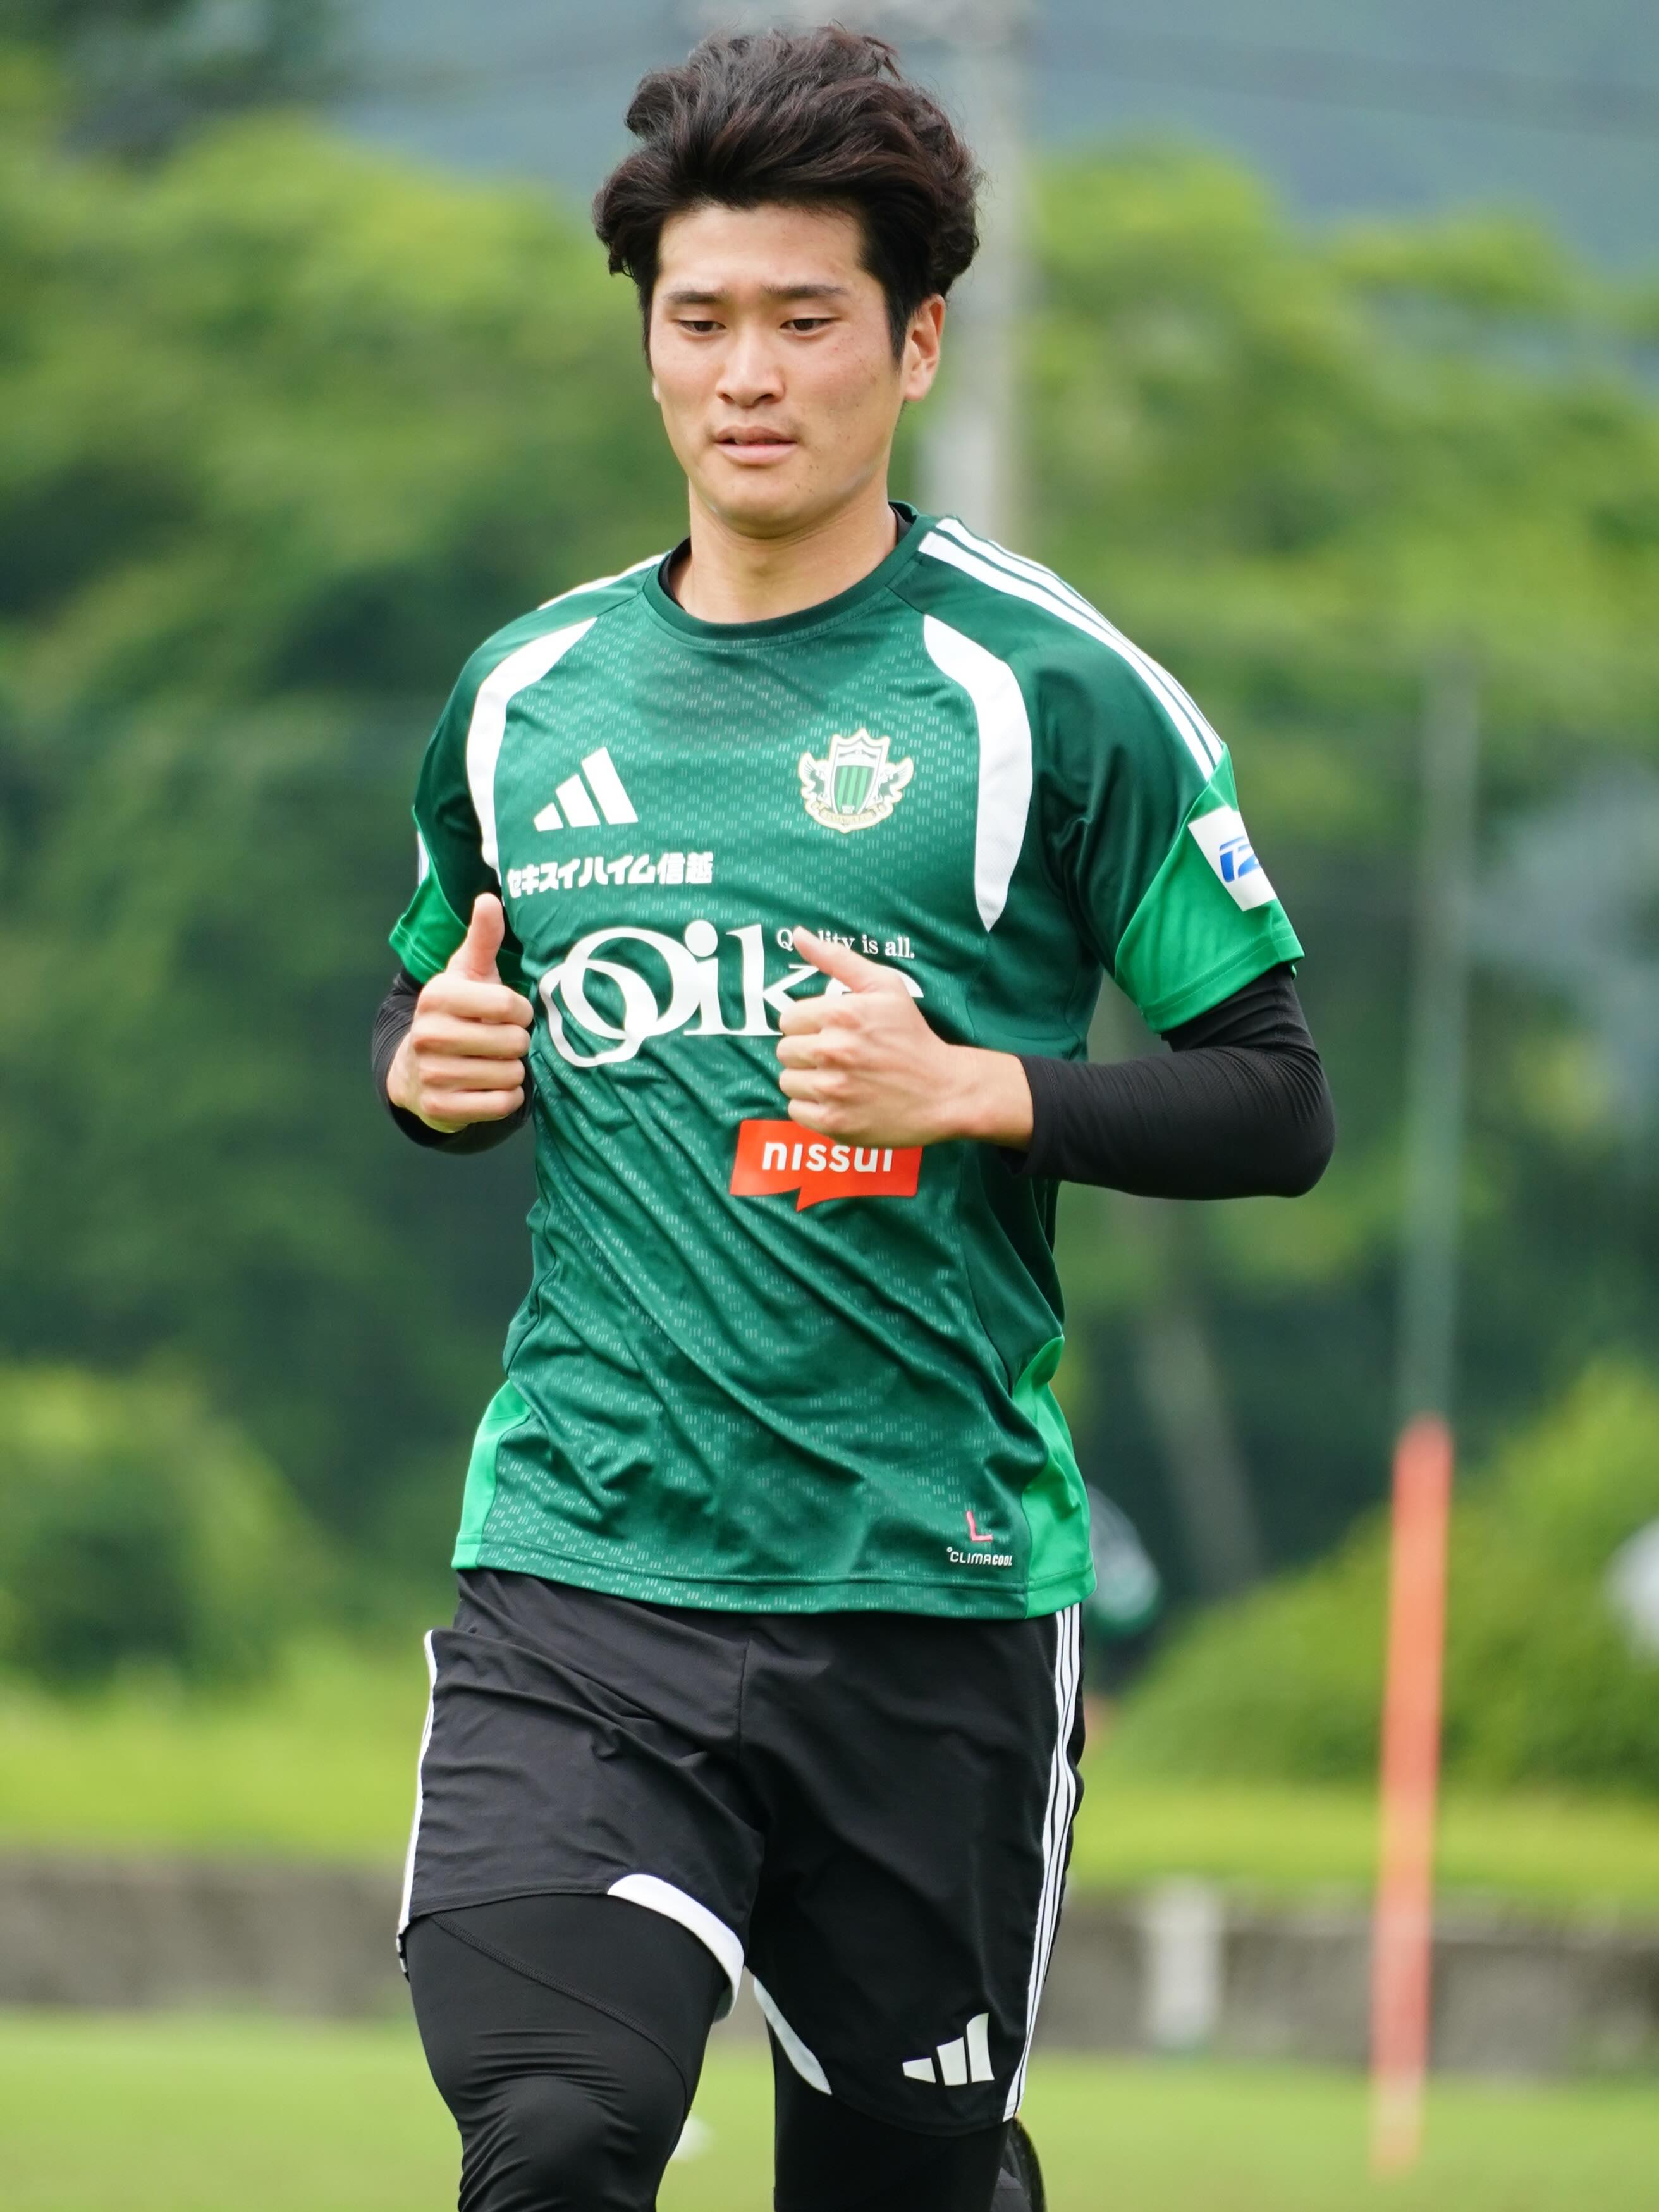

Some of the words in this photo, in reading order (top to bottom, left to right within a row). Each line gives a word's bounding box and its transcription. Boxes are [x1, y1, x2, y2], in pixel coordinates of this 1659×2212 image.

[507, 851, 714, 899] セキスイハイム信越
[776, 928, 855, 951] Qlity
[862, 934, 879, 955] is
[885, 936, 915, 959] all.
[762, 1141, 893, 1173] nissui
[966, 1511, 993, 1542] L
